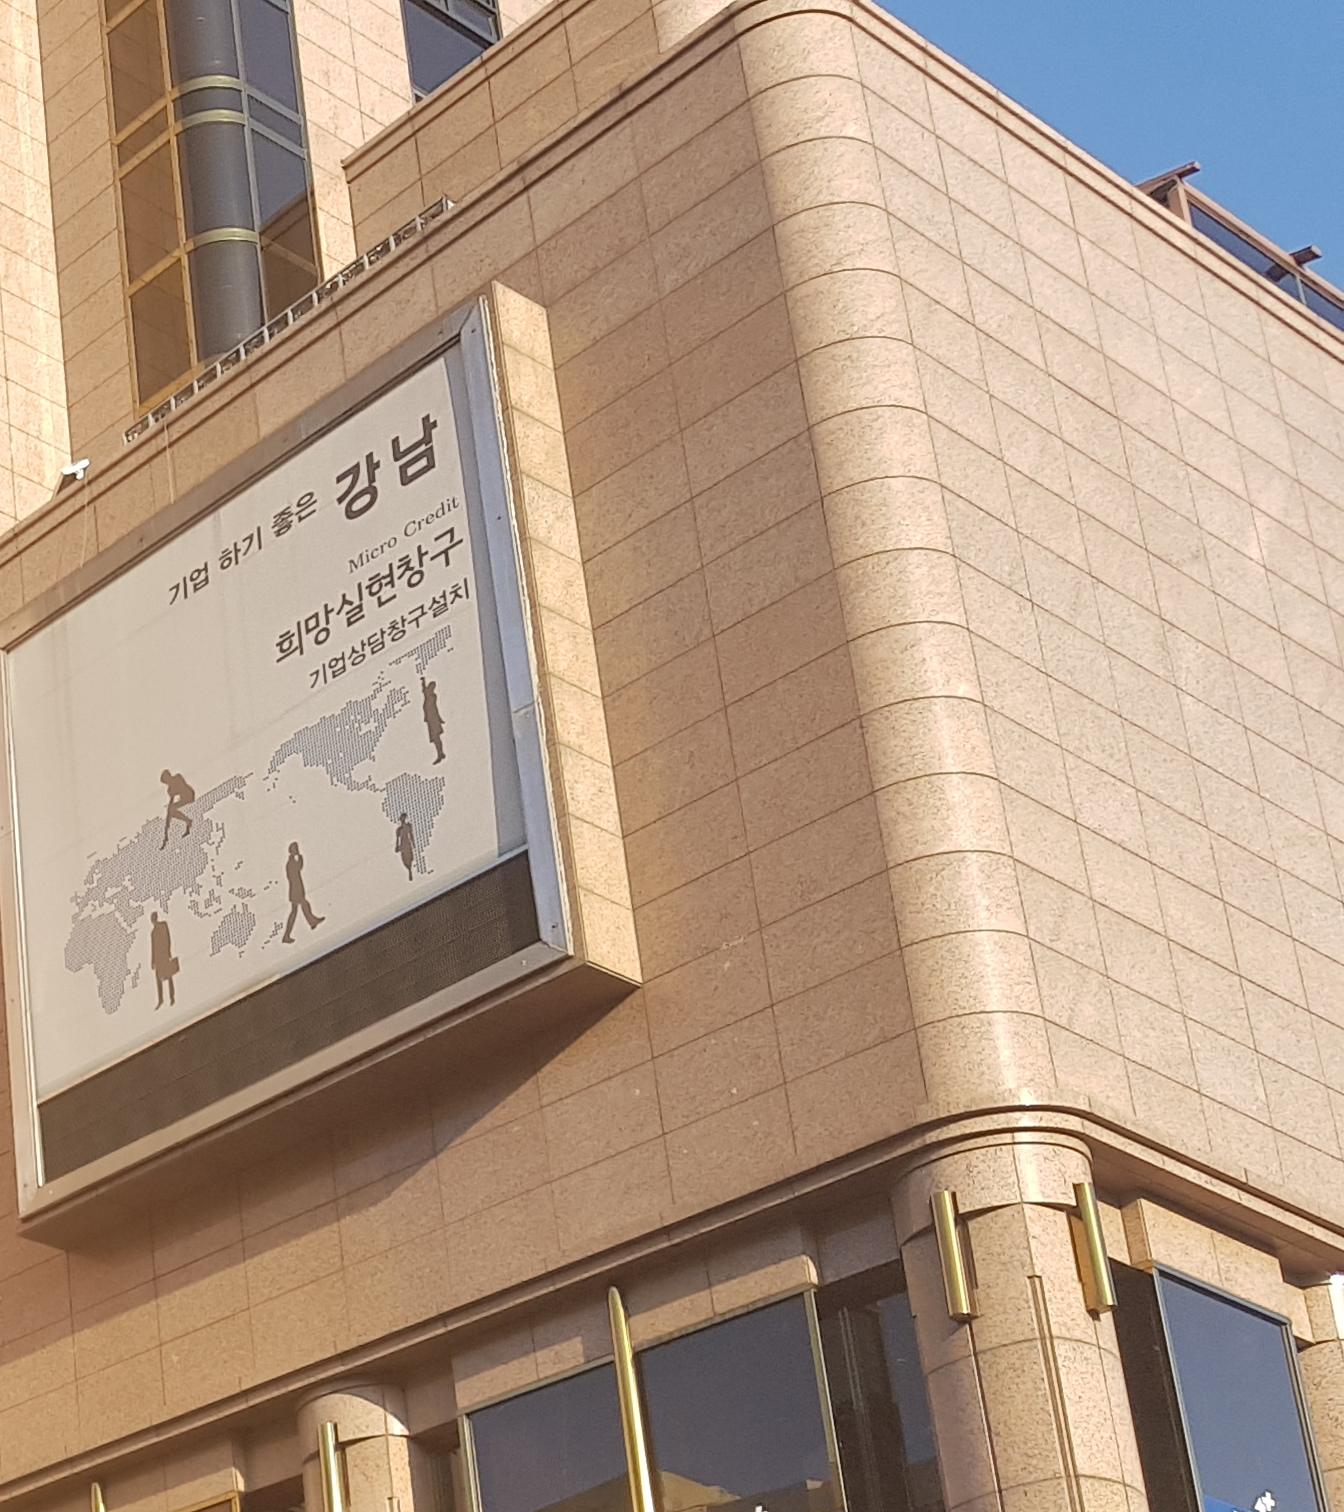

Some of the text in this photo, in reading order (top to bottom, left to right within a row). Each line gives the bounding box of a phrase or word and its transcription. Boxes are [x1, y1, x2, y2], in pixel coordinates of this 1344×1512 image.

[168, 412, 438, 605] 기업 하기 좋은 강남
[347, 495, 460, 574] Micro Credit
[275, 526, 464, 663] 희망실현창구
[309, 577, 470, 688] 기업상담창구설치
